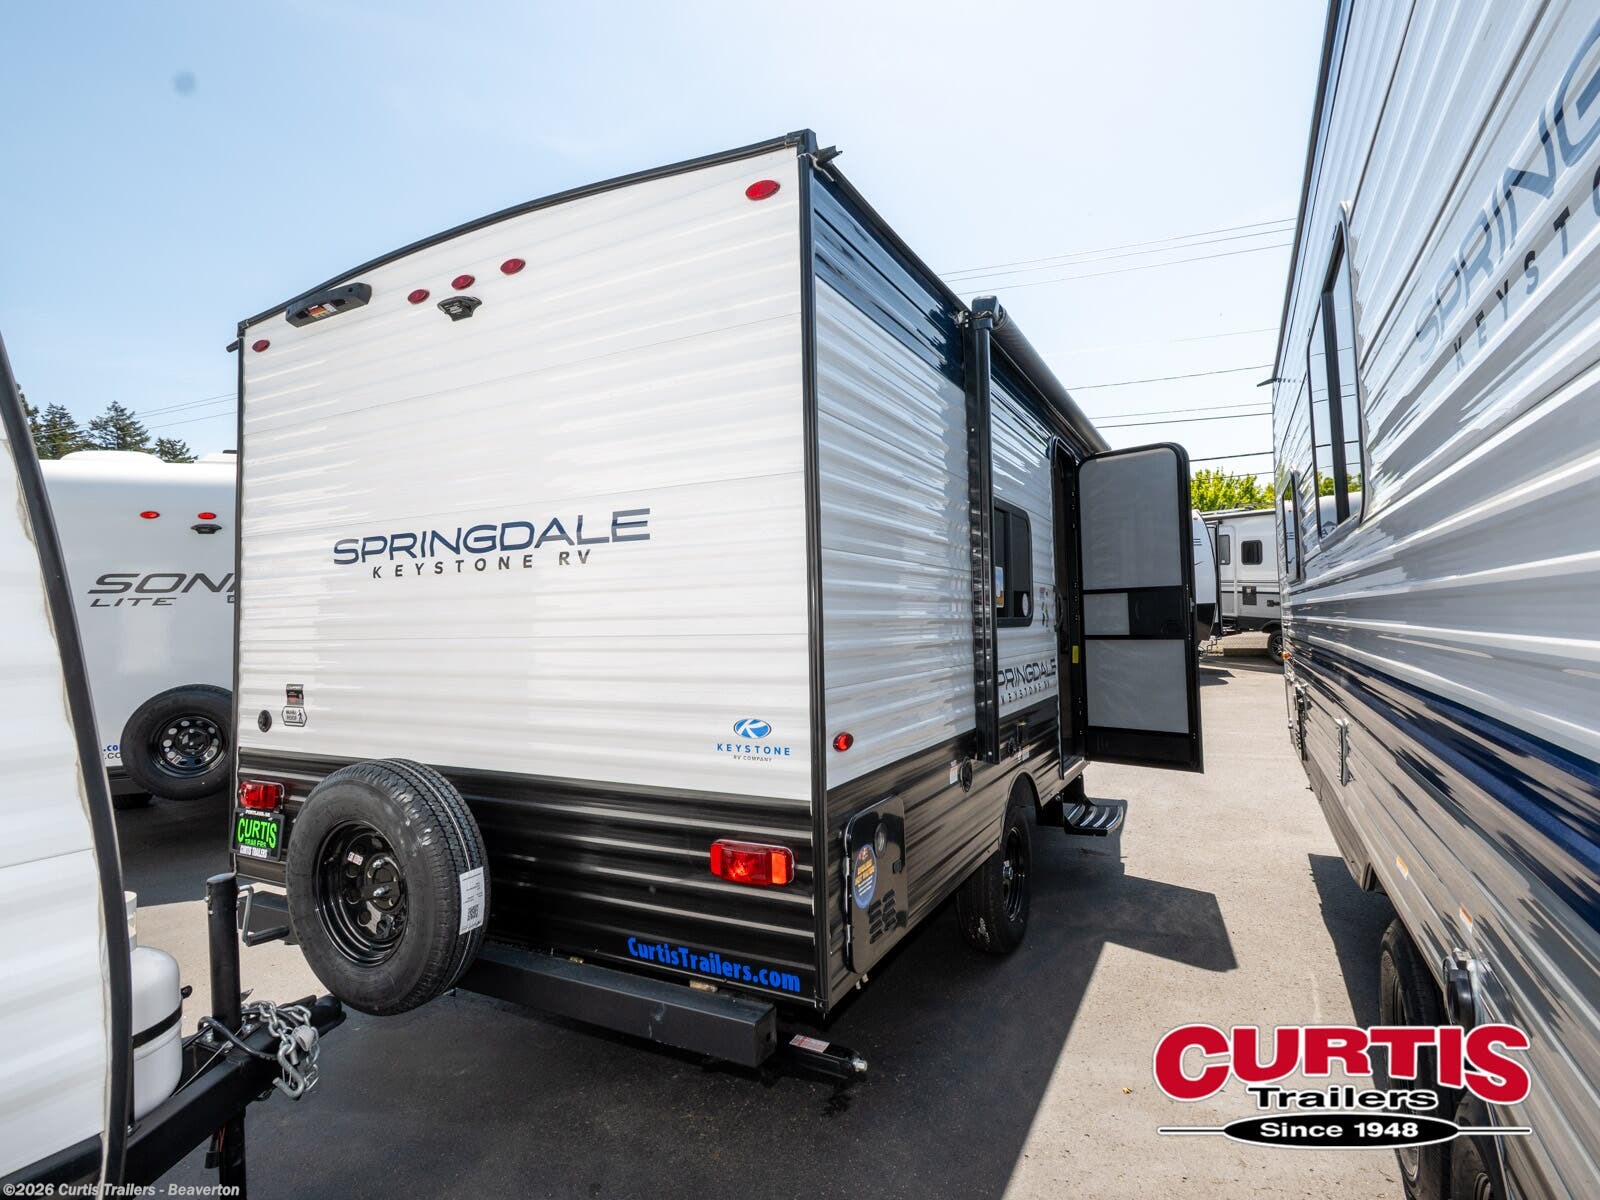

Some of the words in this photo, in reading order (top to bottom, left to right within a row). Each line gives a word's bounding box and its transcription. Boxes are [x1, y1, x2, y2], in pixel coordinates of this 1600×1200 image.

[1453, 165, 1600, 373] KEYST
[333, 508, 651, 565] SPRINGDALE
[372, 554, 533, 579] KEYSTONE
[558, 549, 591, 566] RV
[88, 573, 235, 594] SON
[90, 597, 177, 608] LITE
[717, 743, 791, 756] KEYSTONE
[237, 817, 278, 849] CURTIS
[627, 936, 801, 993] CurtisTrailers.com
